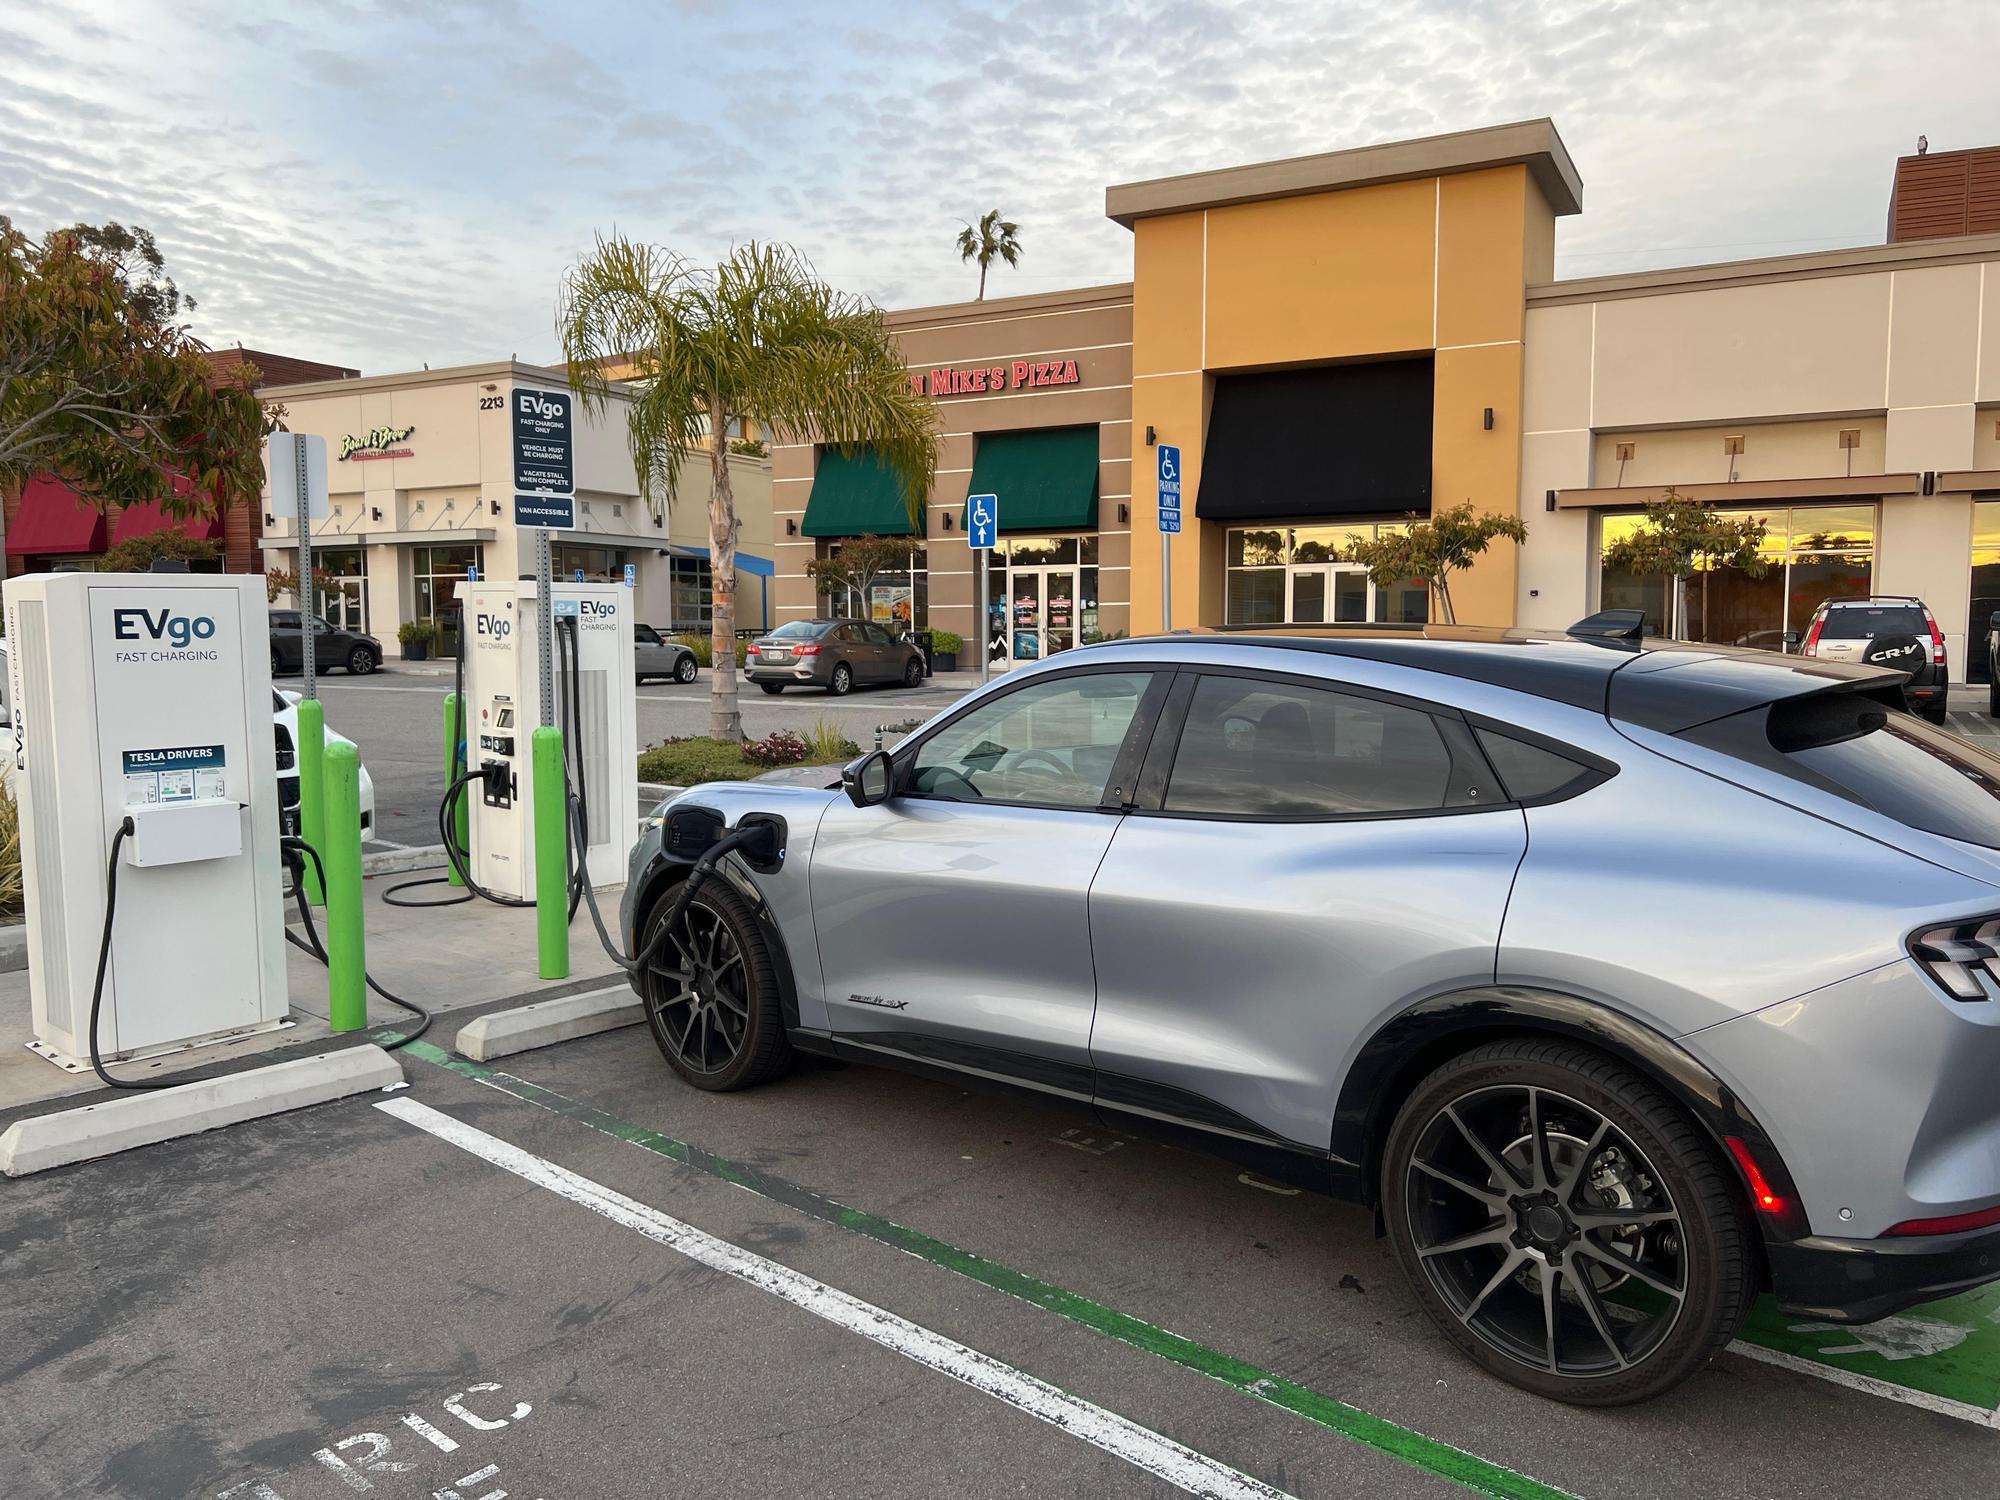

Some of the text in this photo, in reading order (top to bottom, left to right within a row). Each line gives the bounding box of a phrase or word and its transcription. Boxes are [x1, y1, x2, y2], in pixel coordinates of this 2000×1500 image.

[1011, 360, 1080, 389] PIZZA
[480, 396, 504, 410] 2213
[520, 395, 564, 420] EVgo
[520, 418, 565, 429] FAST CHARGING
[534, 426, 551, 434] ONLY
[339, 430, 373, 461] Board
[379, 426, 410, 449] Brew
[521, 444, 546, 452] VEHICLE
[532, 452, 563, 460] CHARGING
[519, 476, 569, 486] WHEN COMPLETE
[523, 470, 565, 480] VACATE STALL
[519, 506, 570, 517] VAN ACCESSIBLE
[581, 600, 616, 618] EVgo
[113, 608, 216, 648] EVgo
[477, 613, 511, 640] EVgo
[581, 623, 617, 631] CHARGING
[9, 606, 18, 671] CHARGING
[477, 642, 511, 651] FAST CHARGING
[1870, 643, 1918, 662] CR-V
[116, 650, 218, 662] FAST CHARGING
[15, 709, 25, 771] EVgo
[129, 748, 213, 763] TESLA DRIVERS
